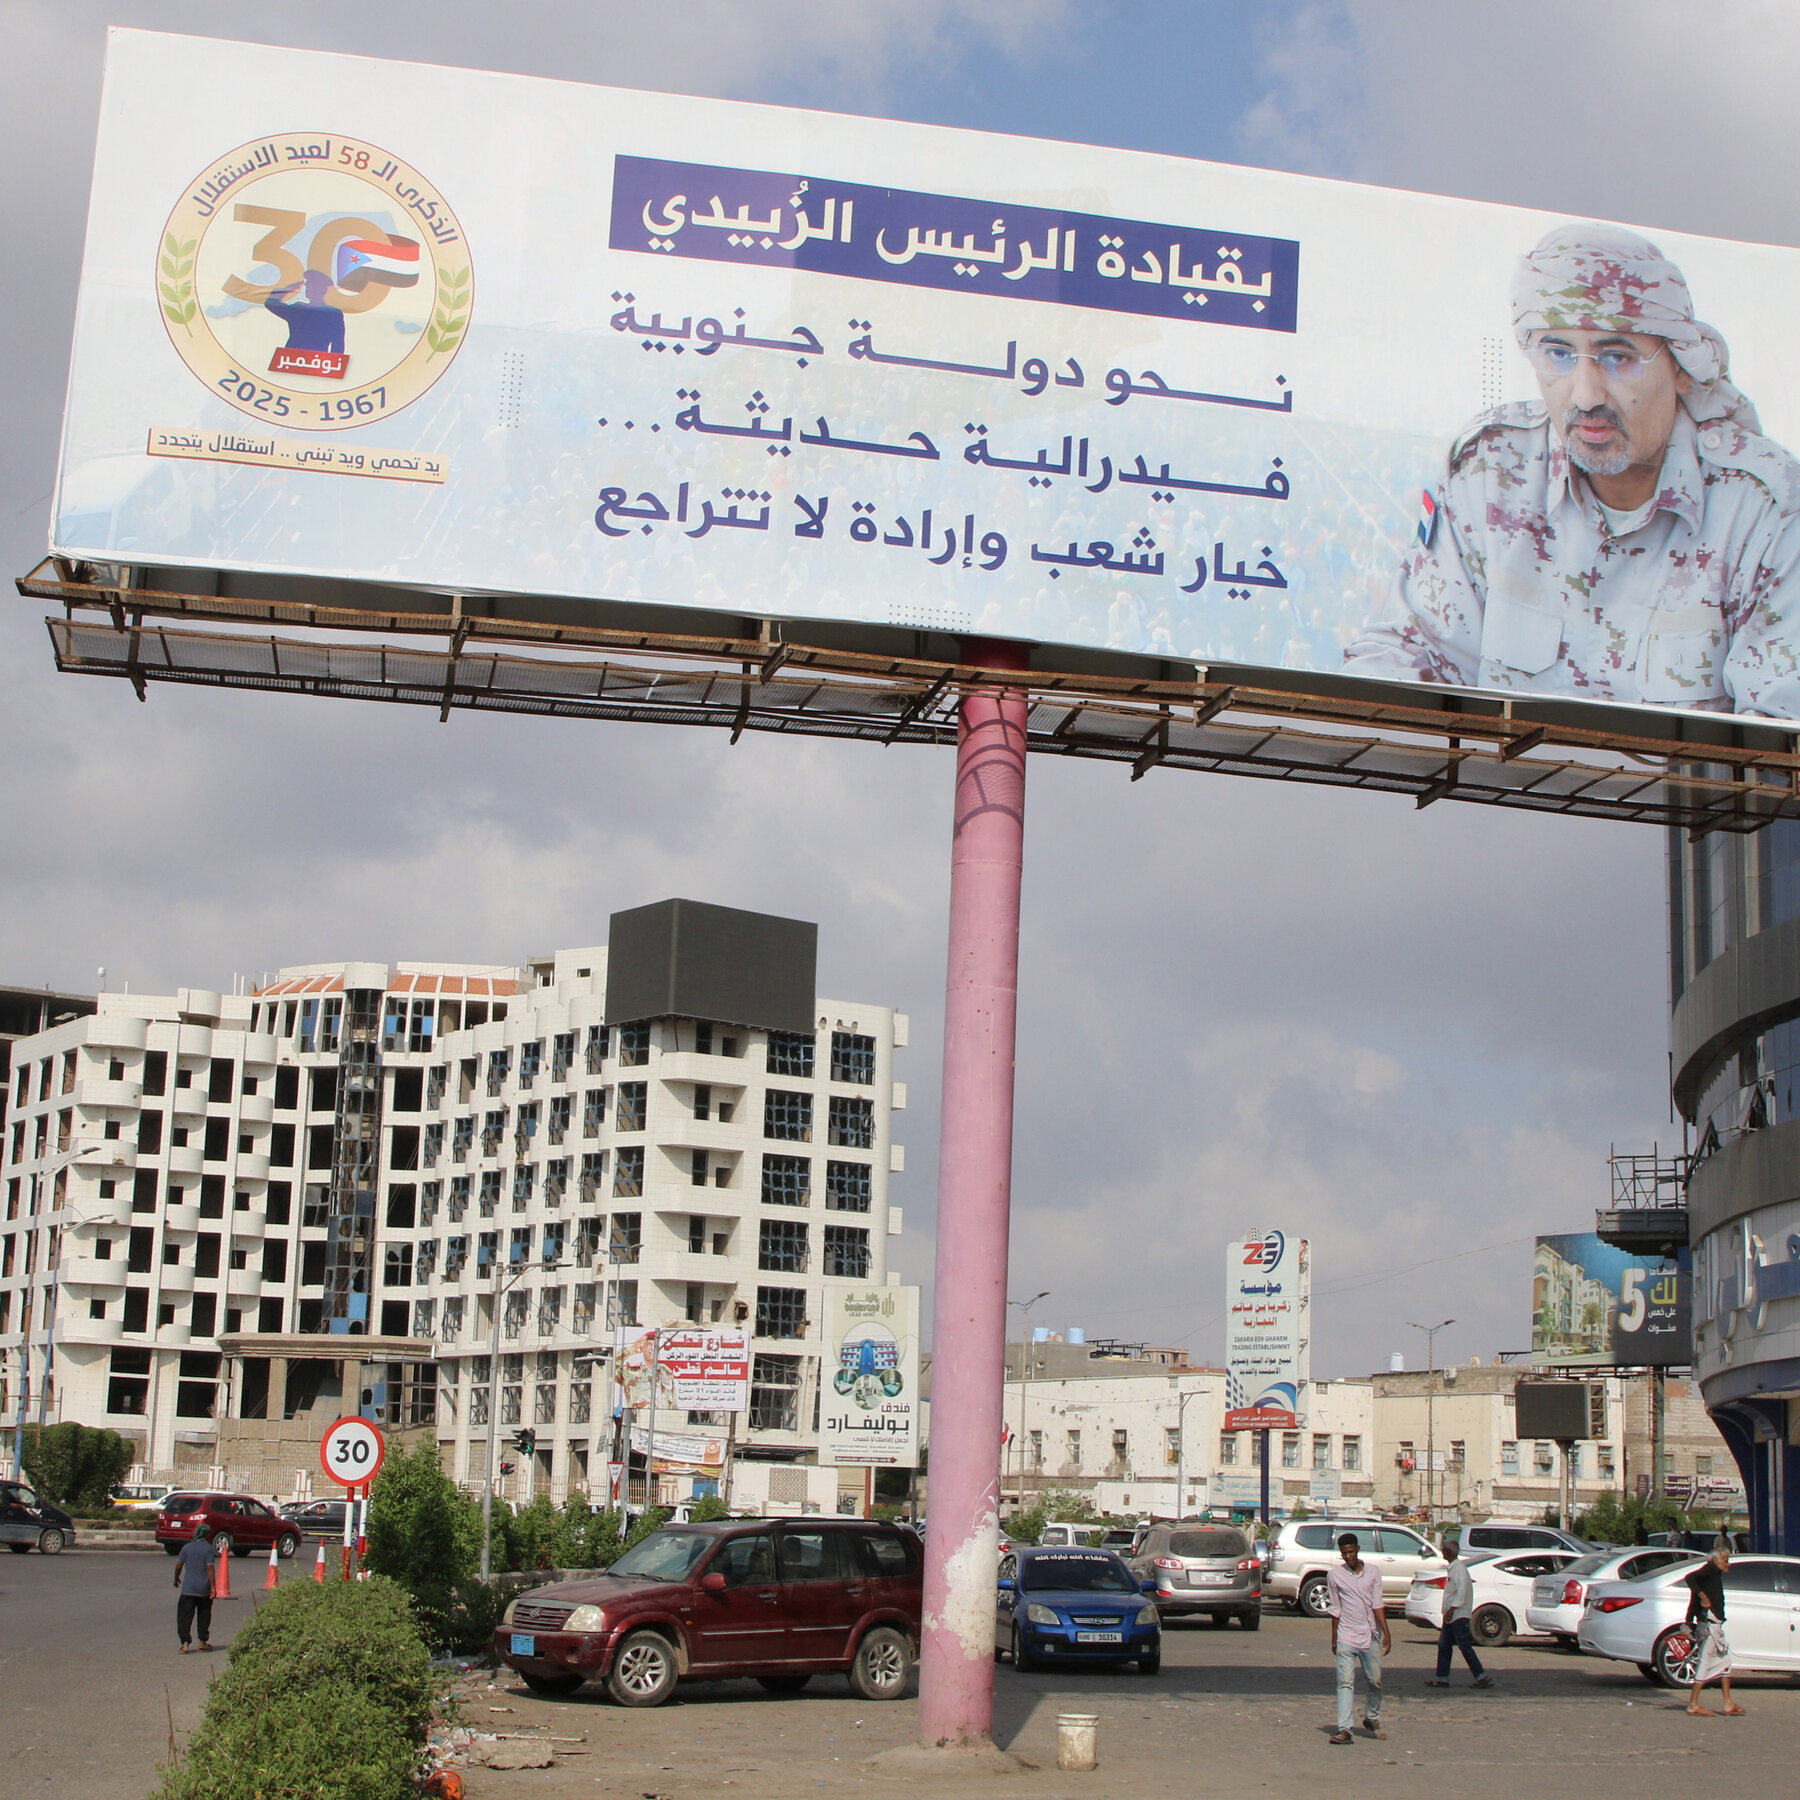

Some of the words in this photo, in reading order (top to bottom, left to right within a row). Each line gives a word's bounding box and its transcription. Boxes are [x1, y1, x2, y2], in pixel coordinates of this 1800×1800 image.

[286, 140, 331, 164] لعيد
[338, 146, 370, 170] 58
[192, 143, 279, 218] الاستقلال
[396, 181, 458, 245] الذكرى
[875, 217, 1077, 281] الرئيس
[1097, 233, 1273, 314] بقيادة
[609, 290, 825, 370] جنوبية
[276, 353, 342, 373] نوفمبر
[846, 317, 1085, 397] دولة
[217, 369, 291, 418] 2025
[319, 385, 388, 422] 1967
[1105, 368, 1294, 414] نحو
[674, 388, 941, 461] حديثة
[158, 431, 203, 452] يتجدد
[209, 434, 275, 457] استقلال
[296, 446, 334, 466] تبني
[339, 450, 365, 472] ويد
[371, 453, 421, 475] تحمي
[424, 458, 441, 477] يد
[963, 420, 1291, 504] فيدرالية
[594, 481, 773, 541] تتراجع
[793, 493, 829, 540] لا
[850, 500, 1008, 573] وإرادة
[1030, 526, 1166, 580] شعب
[1179, 545, 1290, 602] خيار
[1240, 1279, 1282, 1296] مؤسسة
[1618, 1267, 1647, 1333] 5
[1650, 1277, 1677, 1305] لك
[1243, 1316, 1277, 1328] التجارية
[706, 1334, 744, 1351] شارع
[672, 1362, 701, 1378] قطن
[704, 1363, 742, 1379] سالم
[881, 1402, 910, 1413] فندق
[827, 1413, 910, 1435] بوليفارد
[335, 1439, 370, 1464] 30
